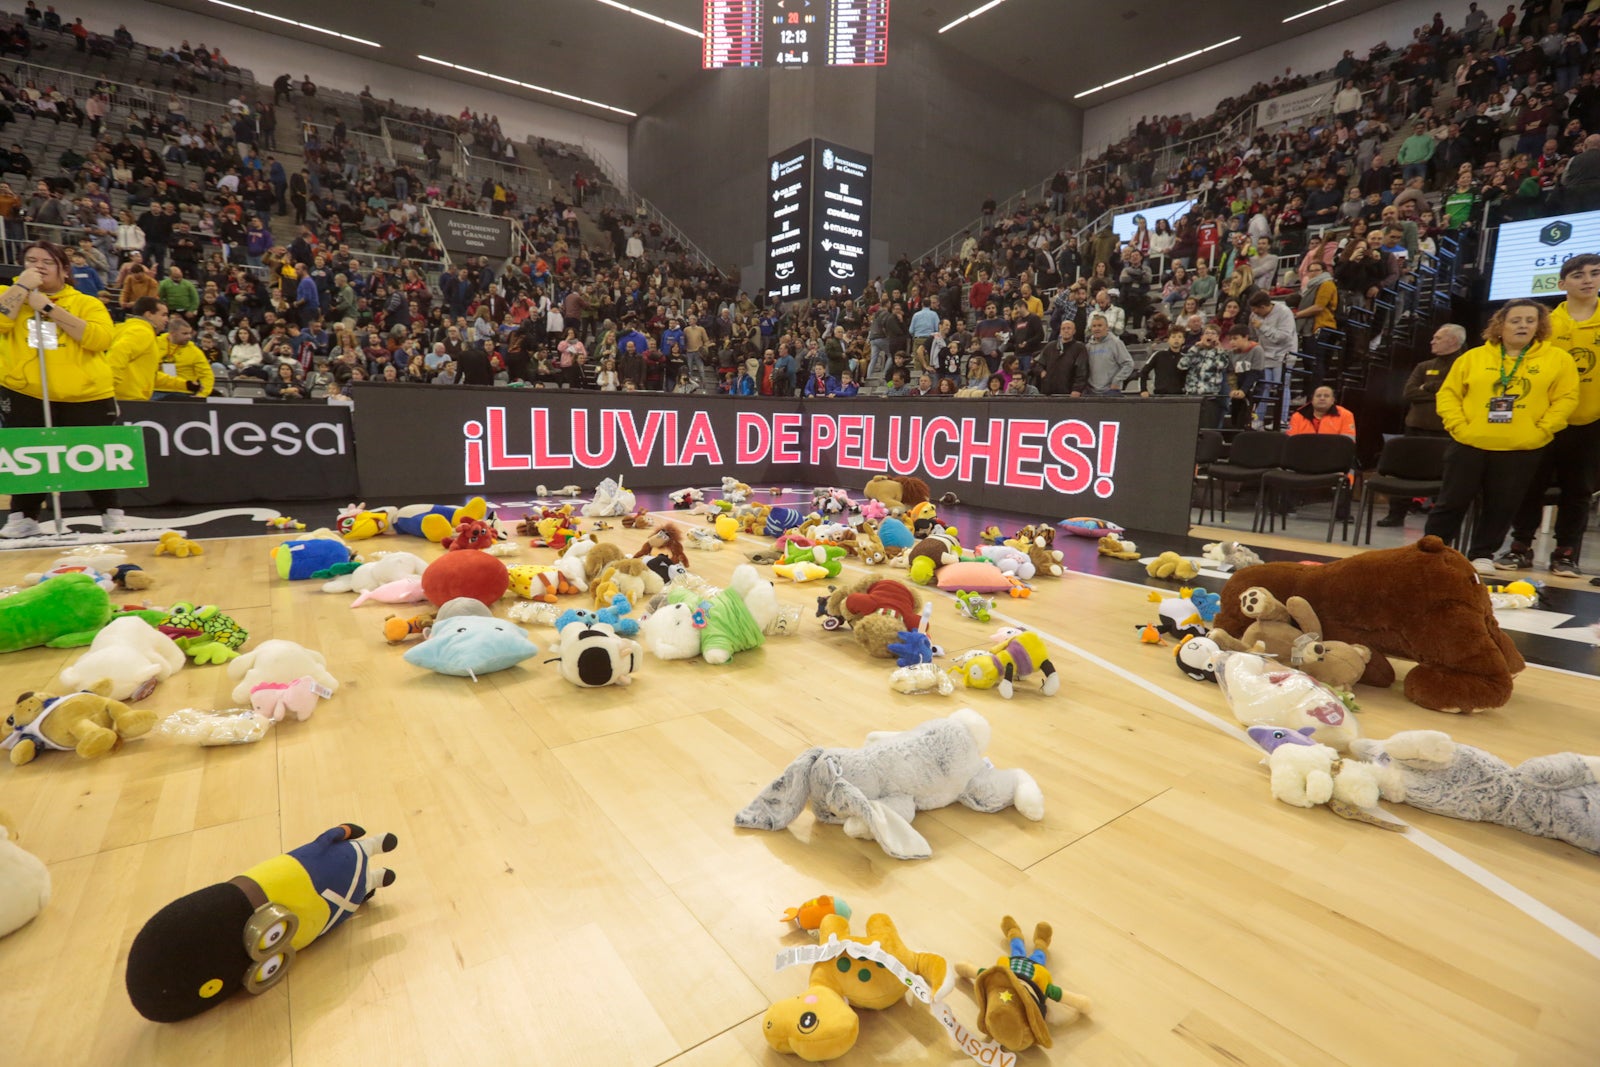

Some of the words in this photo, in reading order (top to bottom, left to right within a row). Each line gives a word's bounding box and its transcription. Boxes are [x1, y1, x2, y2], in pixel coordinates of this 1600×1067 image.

[780, 29, 807, 44] 12:13
[829, 223, 863, 237] emasagra
[1532, 276, 1557, 290] AS
[123, 410, 346, 457] ndesa
[463, 406, 723, 486] ¡LLUVIA
[736, 411, 801, 464] DE
[810, 413, 1120, 498] PELUCHES!
